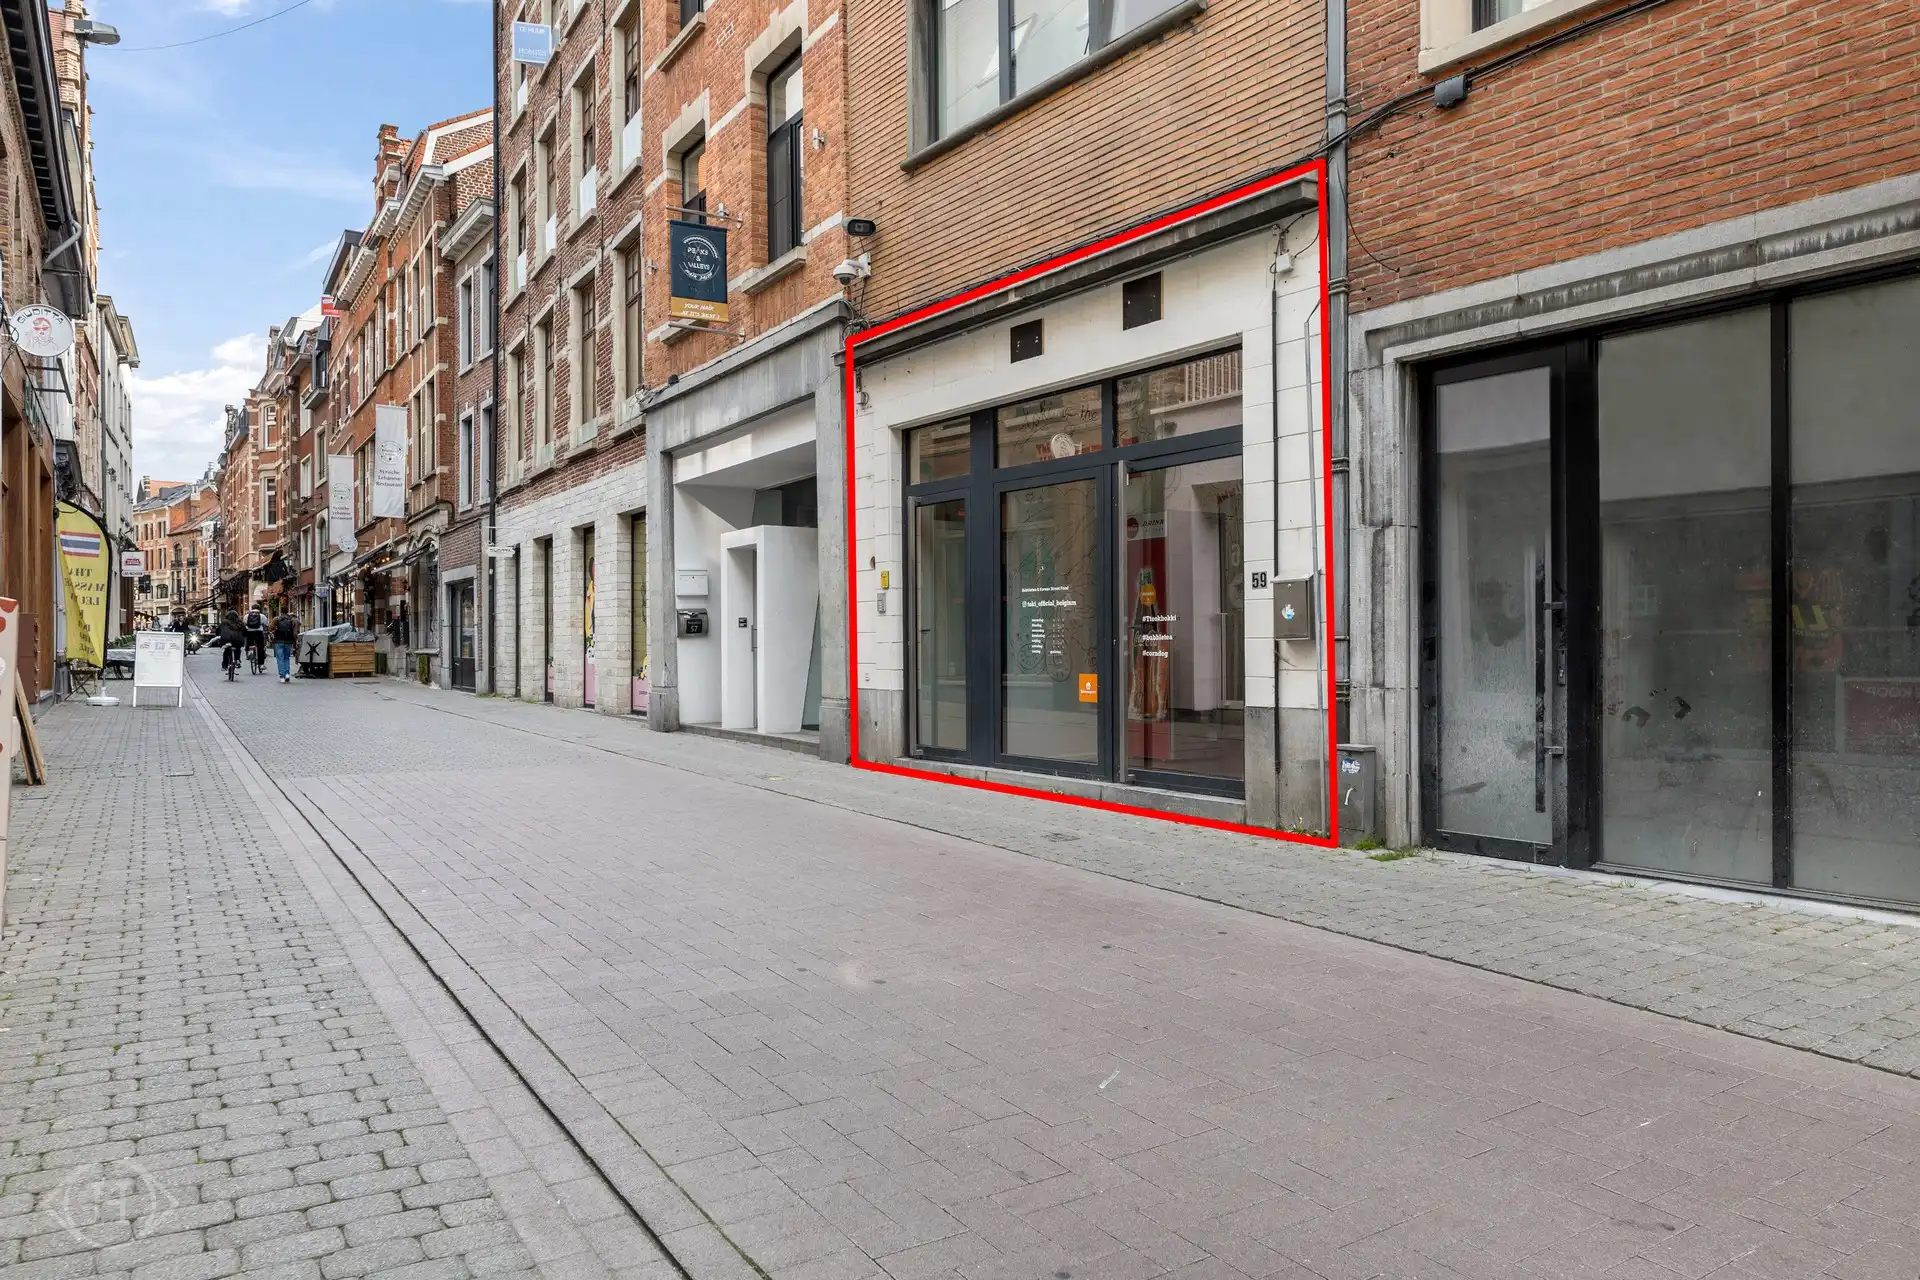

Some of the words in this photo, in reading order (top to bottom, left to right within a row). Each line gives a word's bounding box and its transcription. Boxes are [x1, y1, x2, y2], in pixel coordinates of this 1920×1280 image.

[688, 262, 710, 270] VALLEYS
[700, 303, 715, 312] HAIR
[16, 308, 64, 324] GIUDITTA
[1251, 572, 1267, 588] 59
[690, 625, 699, 633] 57
[1142, 633, 1174, 641] #bubbletea
[1142, 650, 1169, 659] #corndog
